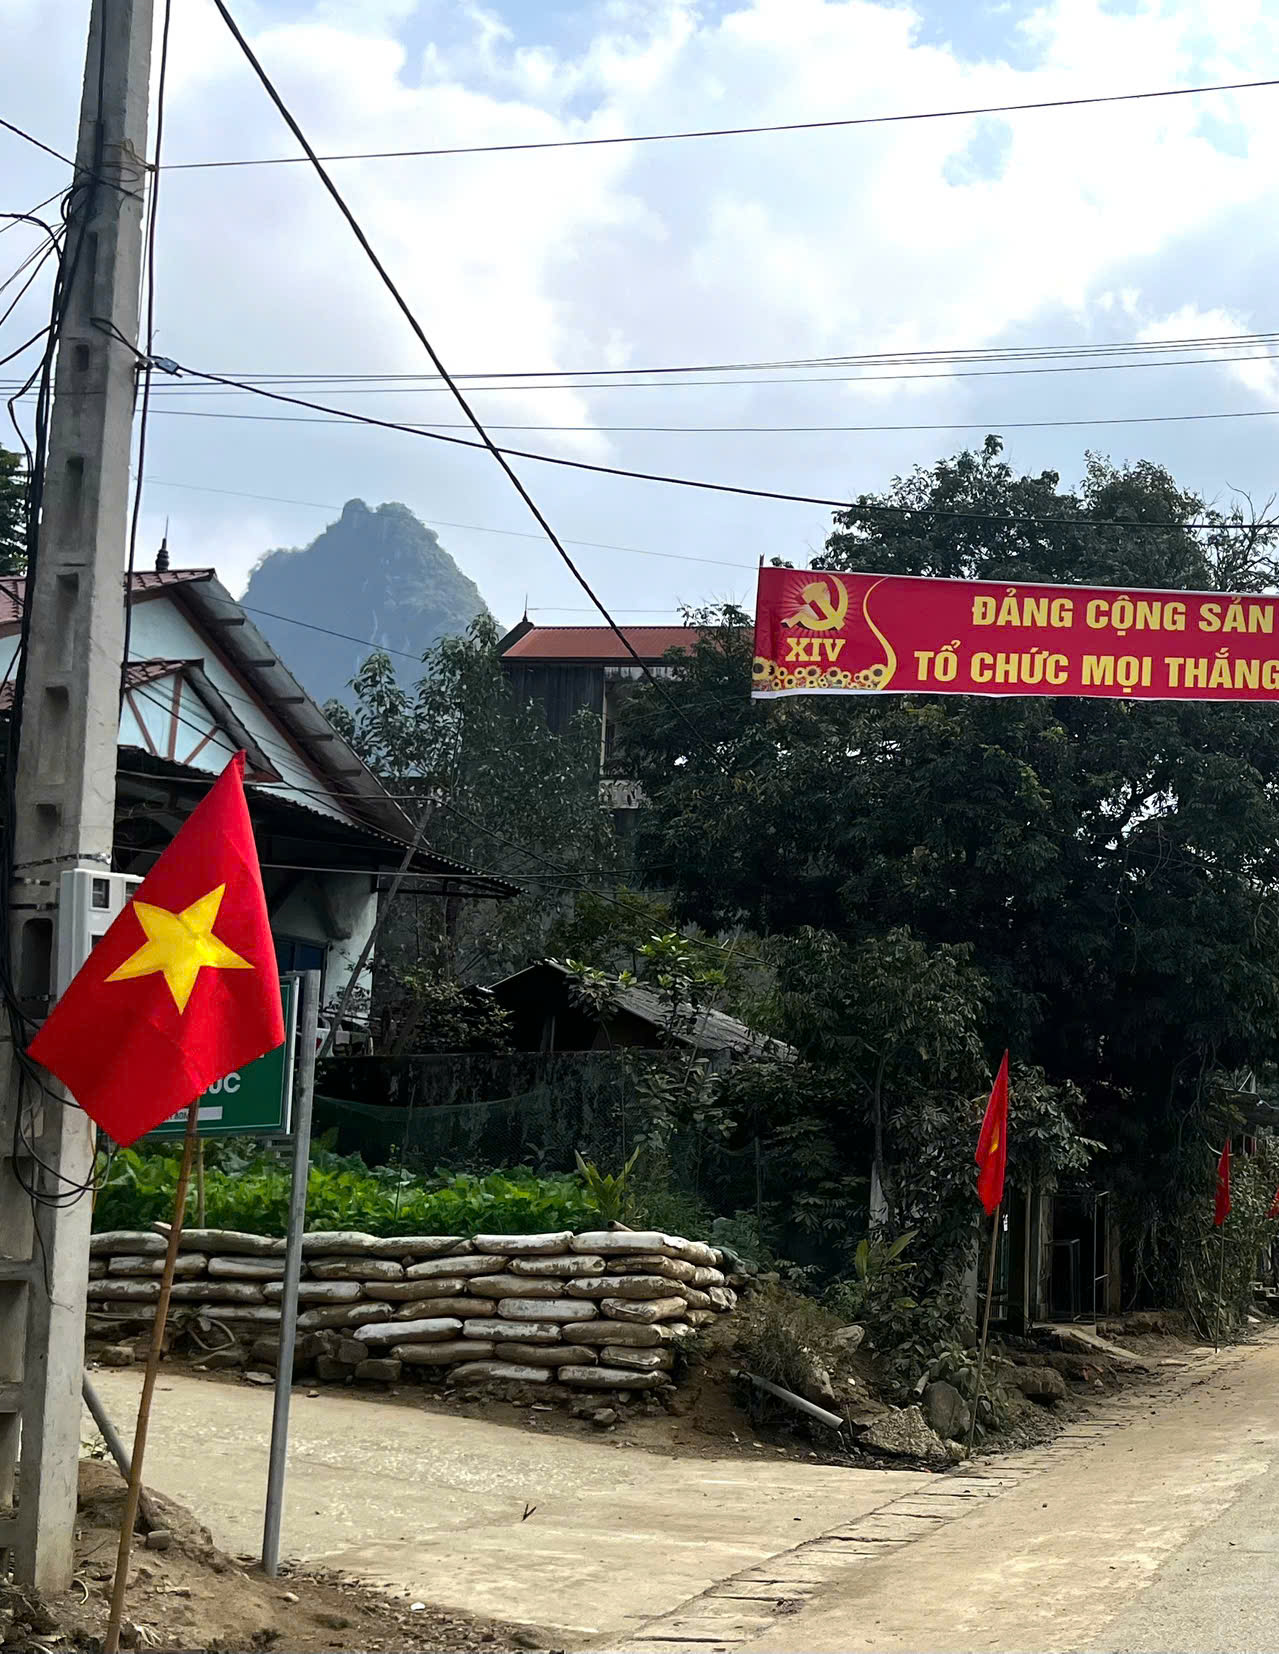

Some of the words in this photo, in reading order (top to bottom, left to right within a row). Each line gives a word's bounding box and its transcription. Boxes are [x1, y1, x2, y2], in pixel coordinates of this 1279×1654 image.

[973, 587, 1073, 628] ĐẢNG
[1087, 595, 1186, 637] CỘNG
[1200, 594, 1274, 633] SẢN
[785, 637, 846, 662] XIV
[914, 639, 961, 682] TỔ
[971, 646, 1069, 685] CHỨC
[1082, 655, 1153, 694] MỌI
